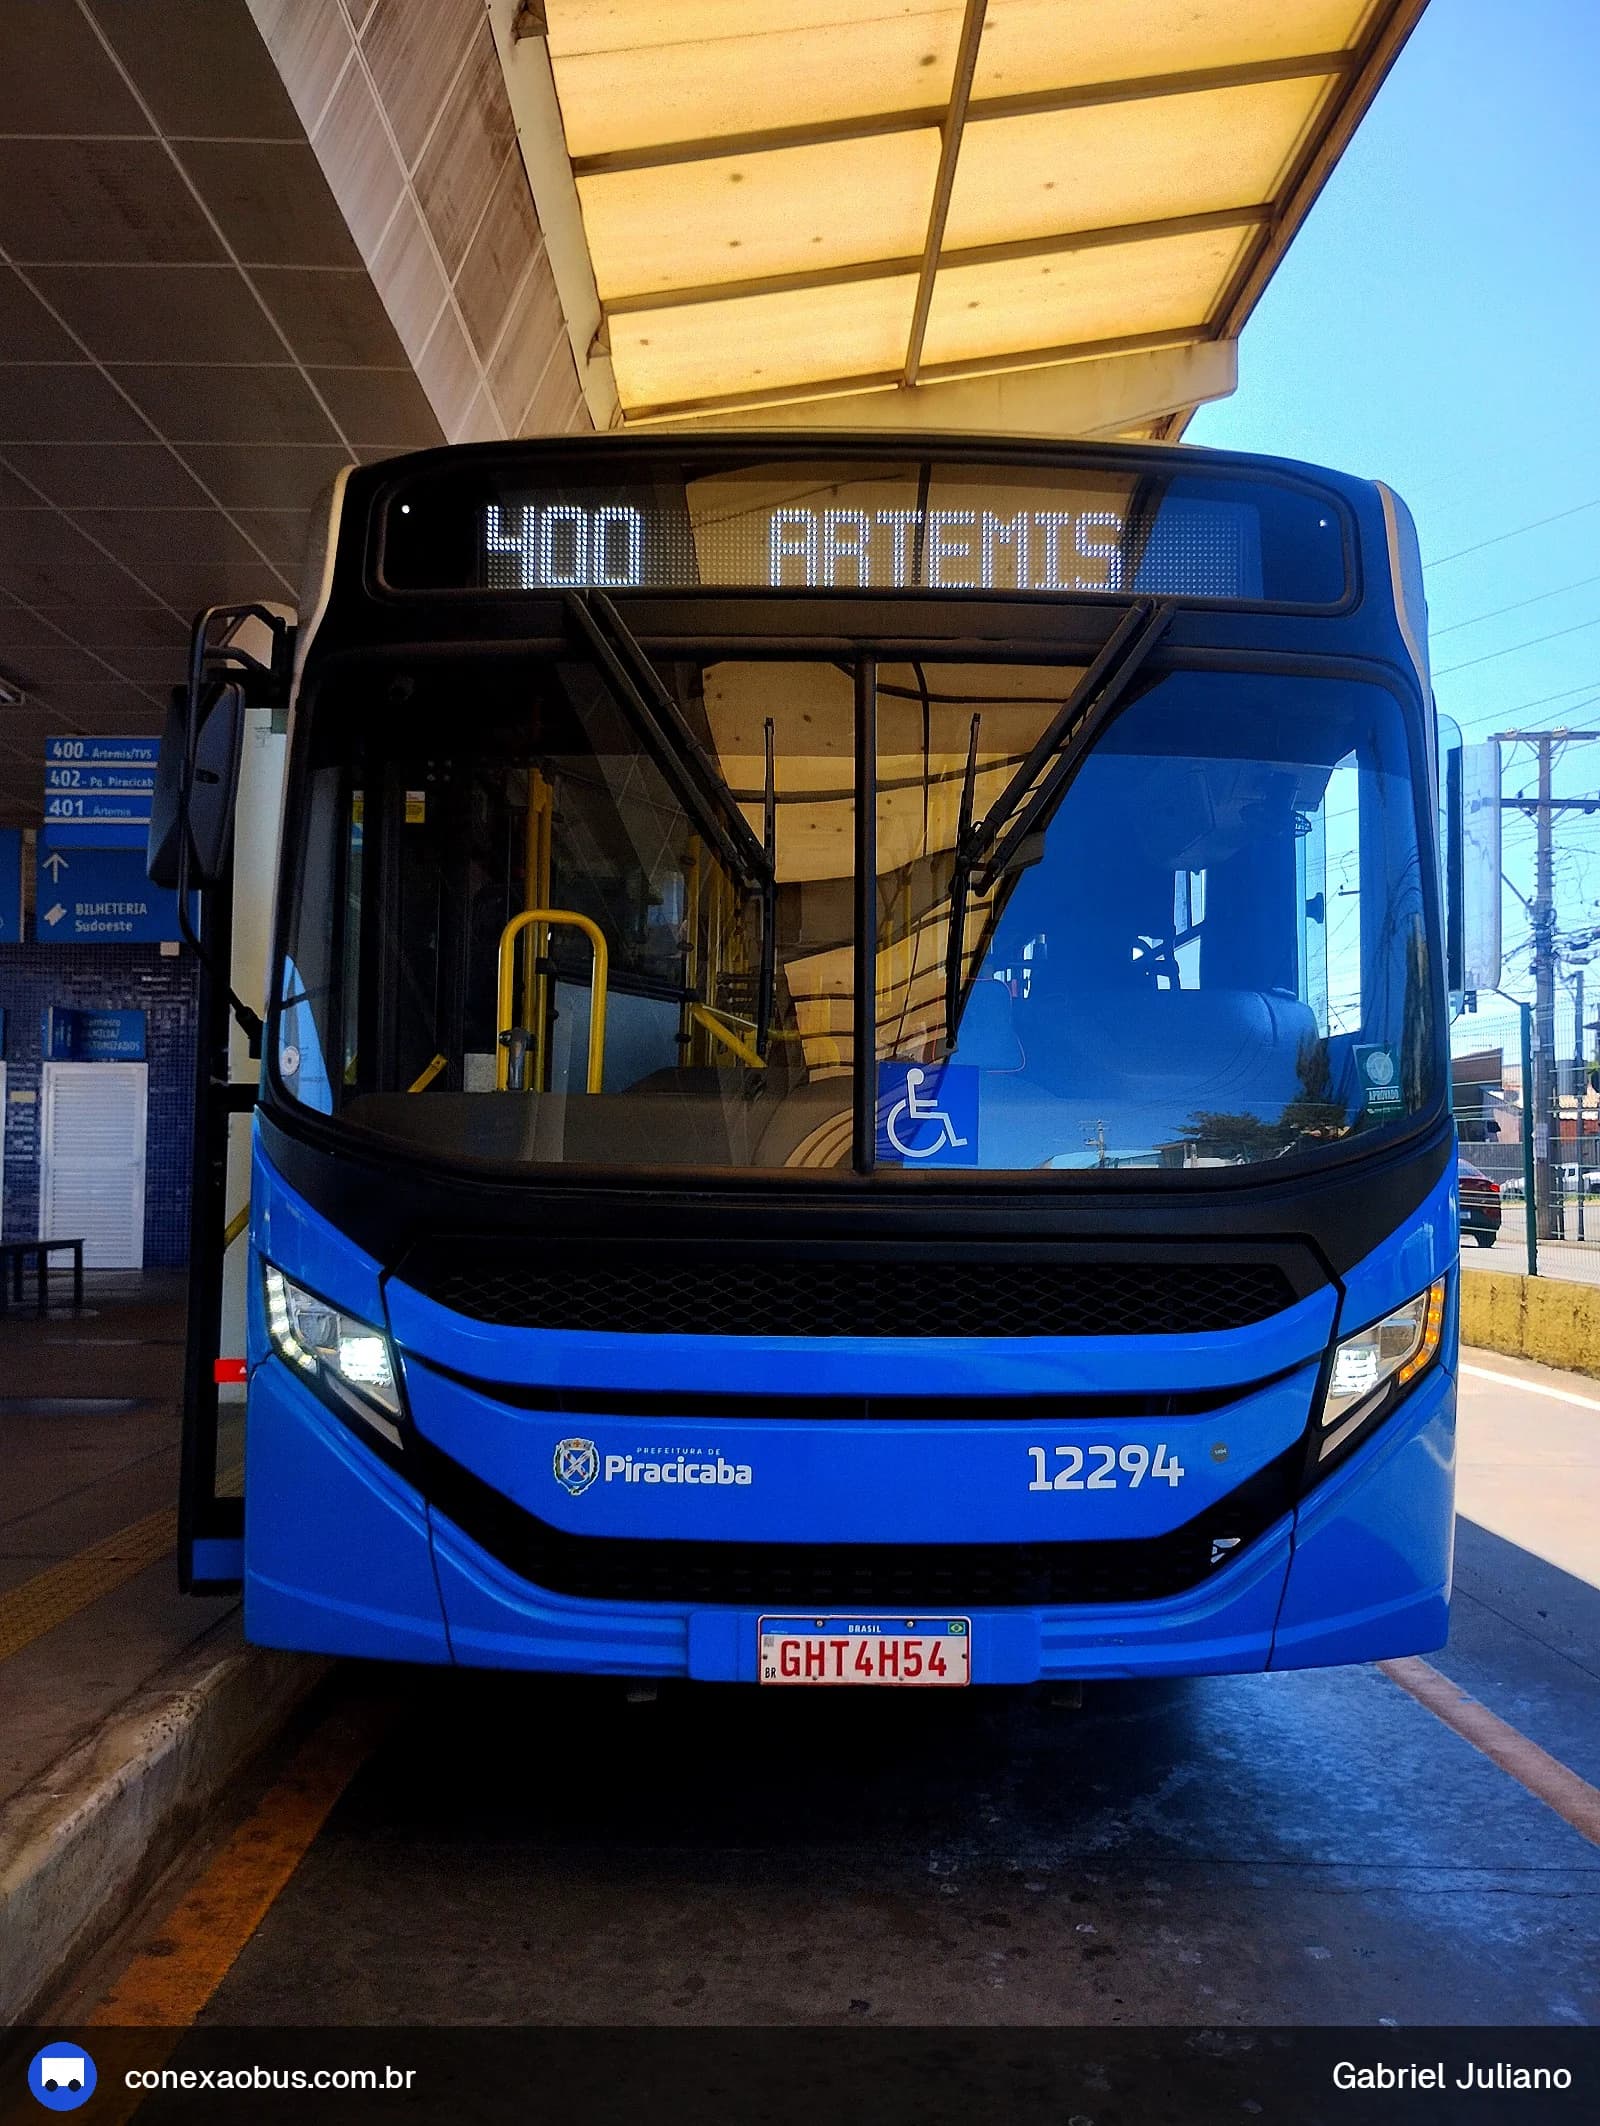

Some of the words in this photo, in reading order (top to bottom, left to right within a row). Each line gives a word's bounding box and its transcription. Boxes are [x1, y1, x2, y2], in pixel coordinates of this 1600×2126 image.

[487, 505, 643, 591] 400
[769, 508, 1123, 592] ARTEMIS
[53, 741, 84, 759] 400
[51, 769, 80, 787] 402
[108, 776, 153, 787] Piracicab
[49, 799, 83, 816] 401
[75, 903, 147, 915] BILHETERIA
[75, 920, 132, 932] Sudoeste
[636, 1447, 702, 1455] PREFEITURA
[605, 1455, 752, 1484] Piracicaba
[1028, 1444, 1184, 1490] 12294
[849, 1624, 881, 1633] BRASIL
[780, 1640, 947, 1677] GHT4H54
[765, 1667, 776, 1679] BR
